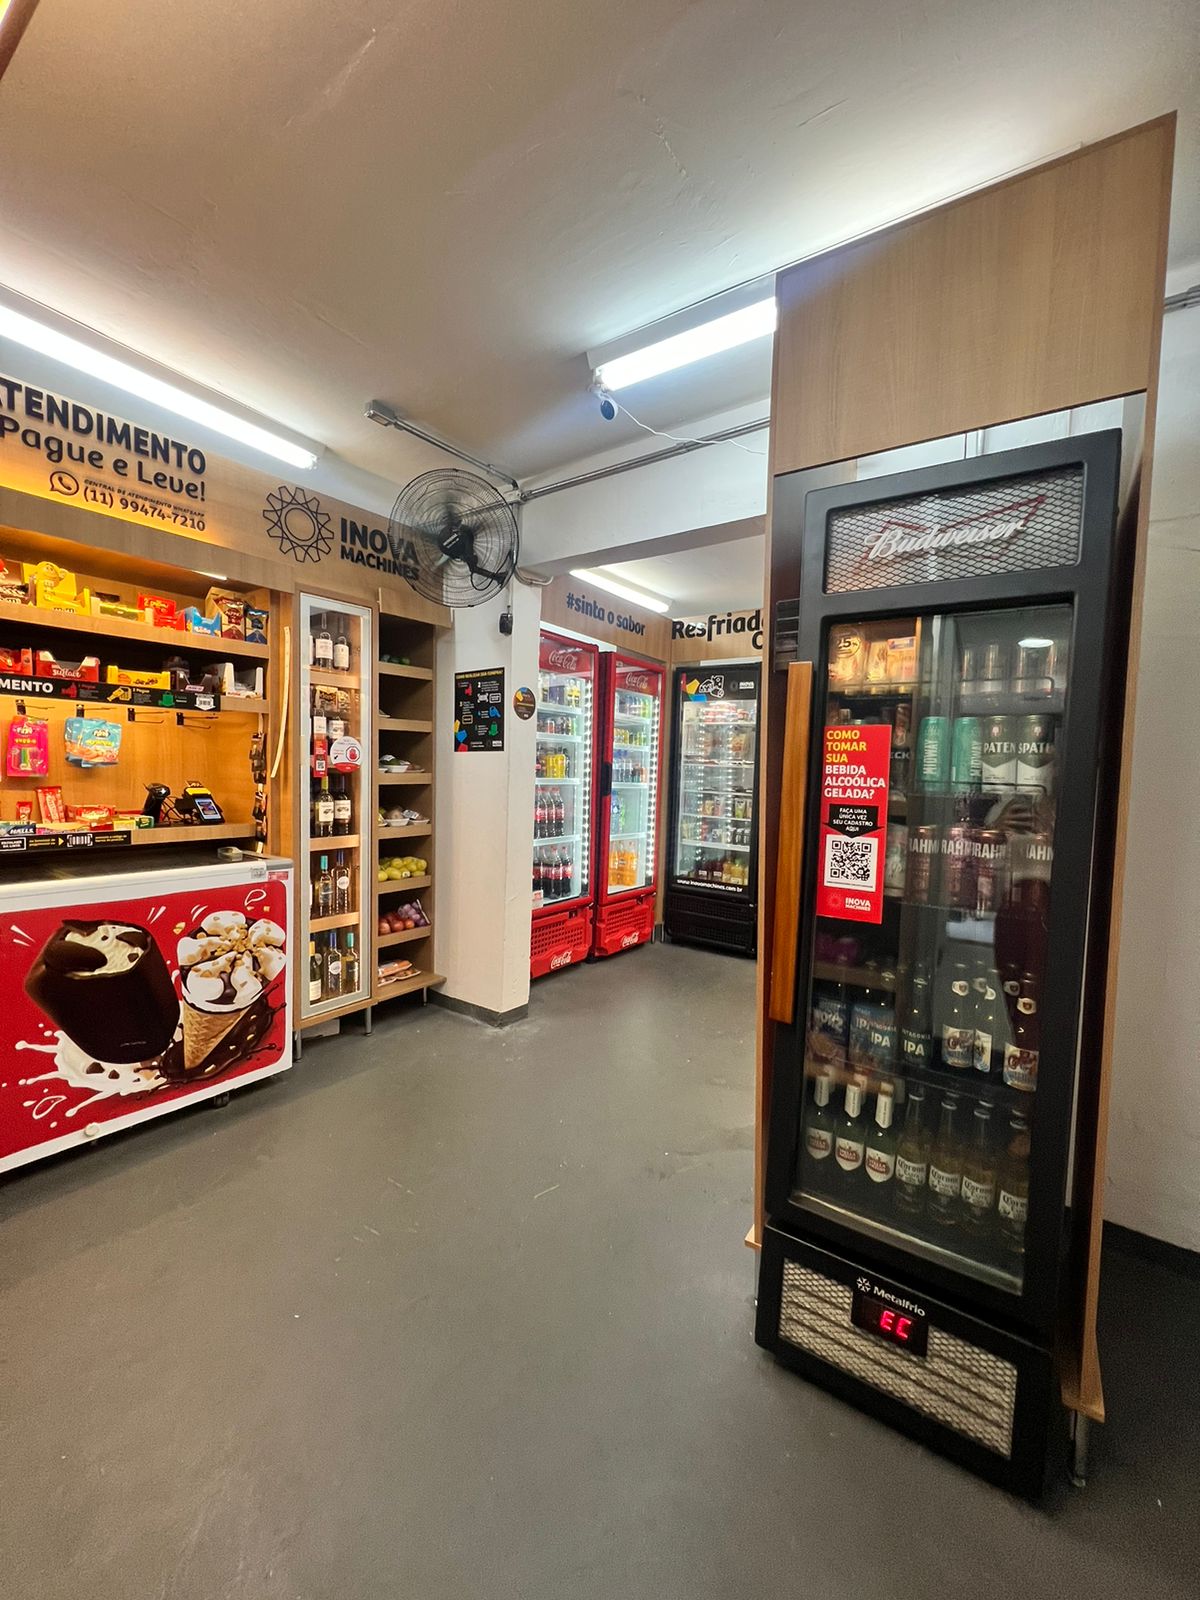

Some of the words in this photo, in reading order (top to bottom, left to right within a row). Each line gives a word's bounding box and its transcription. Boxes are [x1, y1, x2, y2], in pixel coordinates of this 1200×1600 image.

[0, 377, 207, 475] TENDIMENTO
[0, 414, 104, 470] Pague
[112, 458, 129, 477] e
[84, 479, 116, 493] CENTRAL
[83, 486, 114, 509] (11)
[119, 497, 206, 532] 99474-7210
[341, 517, 419, 567] INOVA
[864, 519, 1025, 561] Budweiser
[341, 545, 420, 580] MACHINES
[566, 592, 605, 622] #sinta
[607, 611, 615, 625] o
[616, 615, 646, 636] sabor
[672, 610, 763, 642] Resfriad
[826, 730, 860, 740] COMO
[826, 741, 867, 752] TOMAR
[983, 742, 1016, 754] PATEN
[825, 753, 849, 763] SUA
[825, 765, 867, 775] BEBIDA
[824, 774, 886, 788] ALCOÓLICA
[824, 788, 876, 799] GELADA?
[838, 813, 857, 821] ÚNICA
[845, 897, 871, 908] INOVA
[870, 1031, 891, 1048] IPA
[904, 1039, 925, 1057] IPA
[873, 1286, 926, 1317] Metalfrio
[879, 1310, 913, 1340] EC
